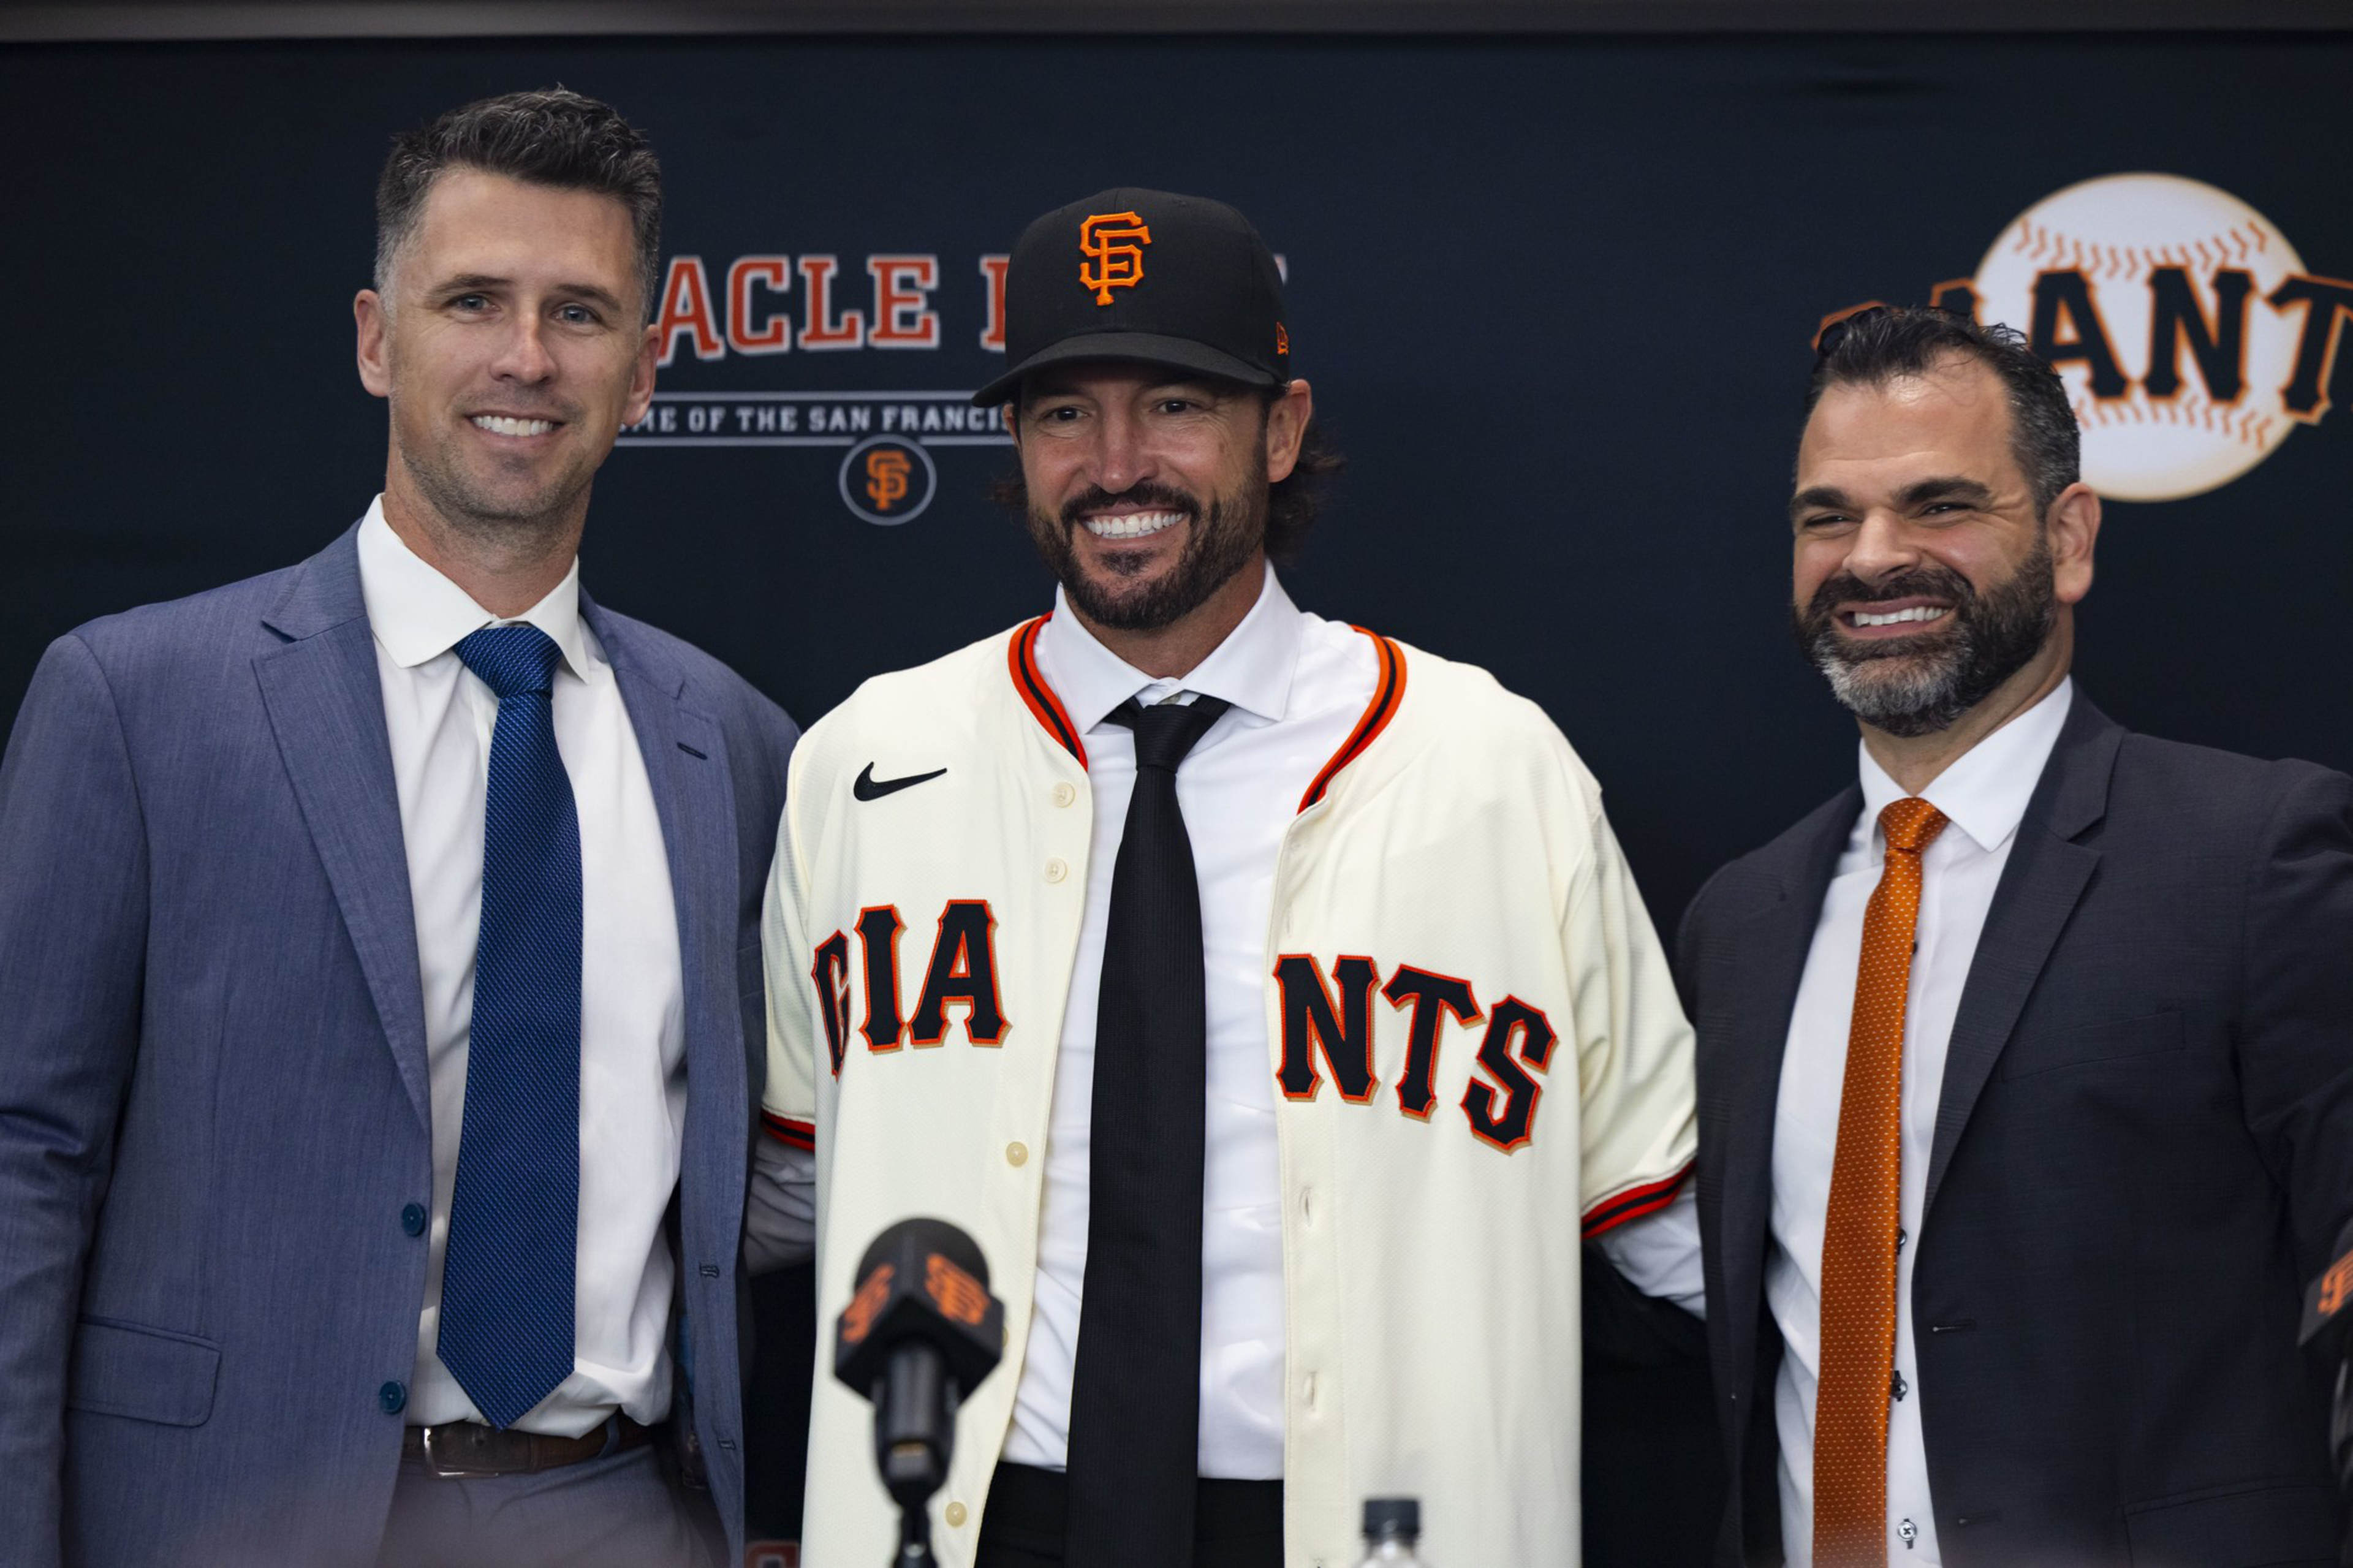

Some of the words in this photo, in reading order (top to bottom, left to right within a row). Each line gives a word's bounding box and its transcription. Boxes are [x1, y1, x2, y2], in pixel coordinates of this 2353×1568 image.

[1079, 211, 1152, 306] SF
[688, 405, 726, 432] OF
[736, 405, 798, 432] THE
[808, 405, 871, 432] SAN
[866, 450, 912, 511] SF
